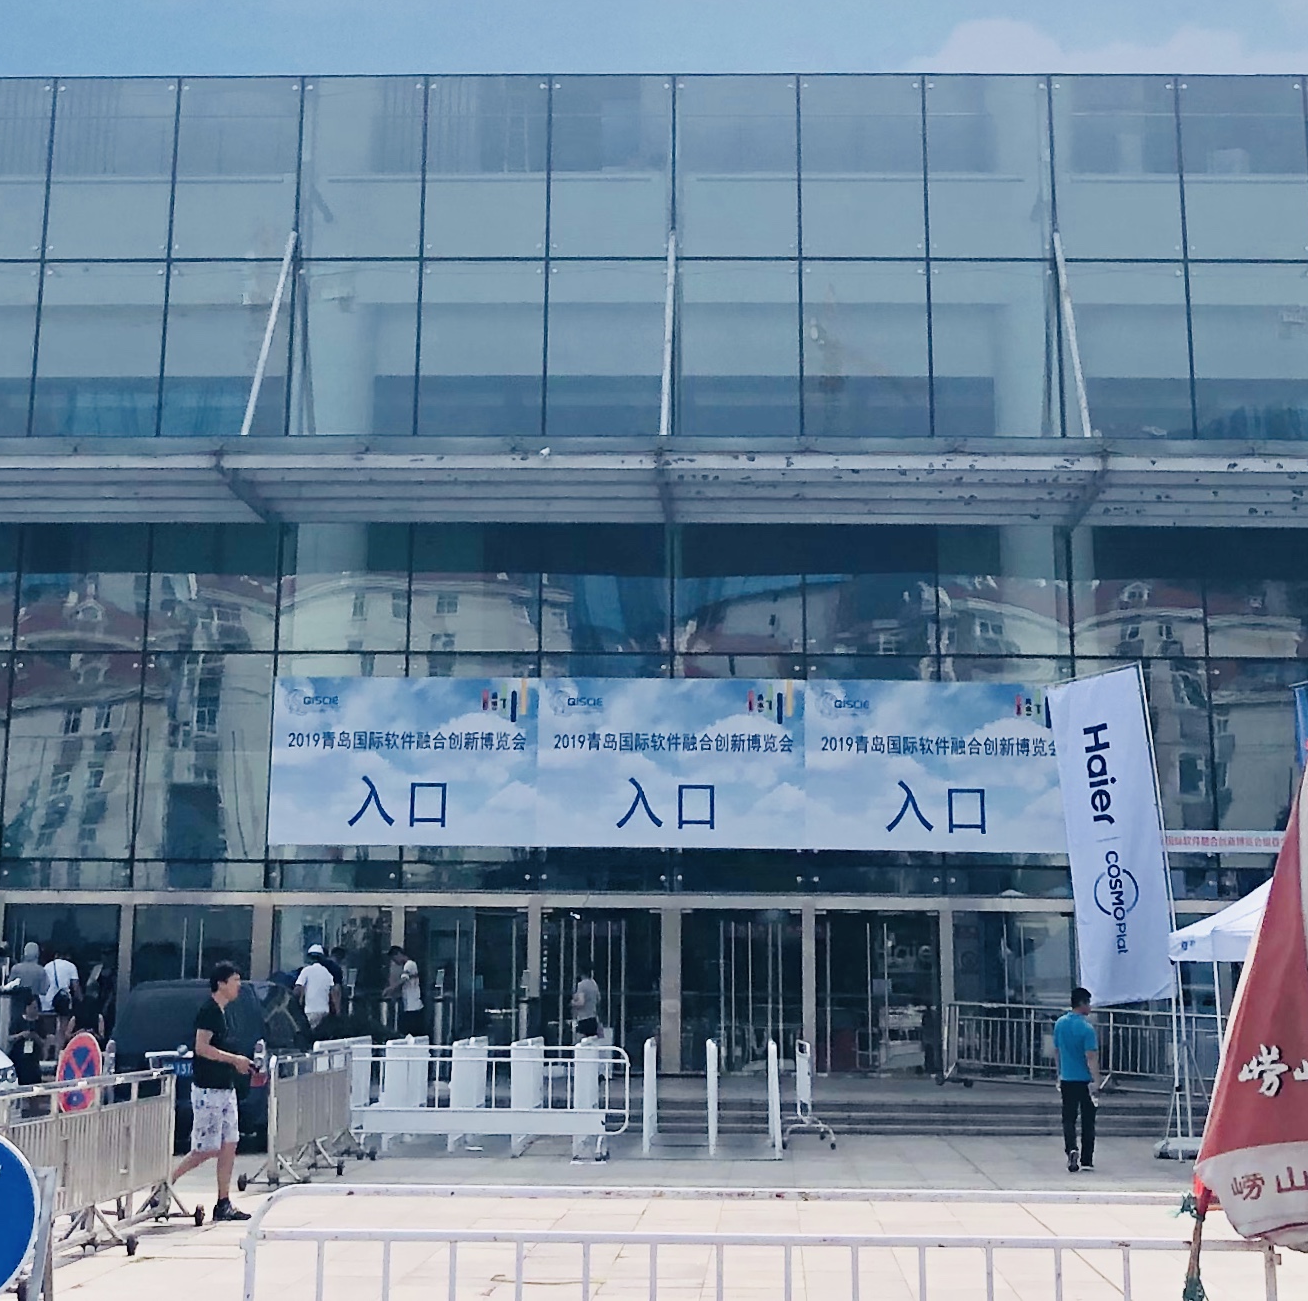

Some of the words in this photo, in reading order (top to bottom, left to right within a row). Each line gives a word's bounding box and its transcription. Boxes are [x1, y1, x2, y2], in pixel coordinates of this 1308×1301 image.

[288, 730, 527, 751] 2019青岛国际软件融合创新博览会
[553, 732, 795, 753] 2019青岛国际软件融合创新博览会
[347, 774, 448, 828] 入口
[1082, 722, 1117, 826] Haier
[616, 776, 715, 829] 入口
[885, 779, 987, 834] 入口
[1104, 849, 1130, 955] COSMOPlat
